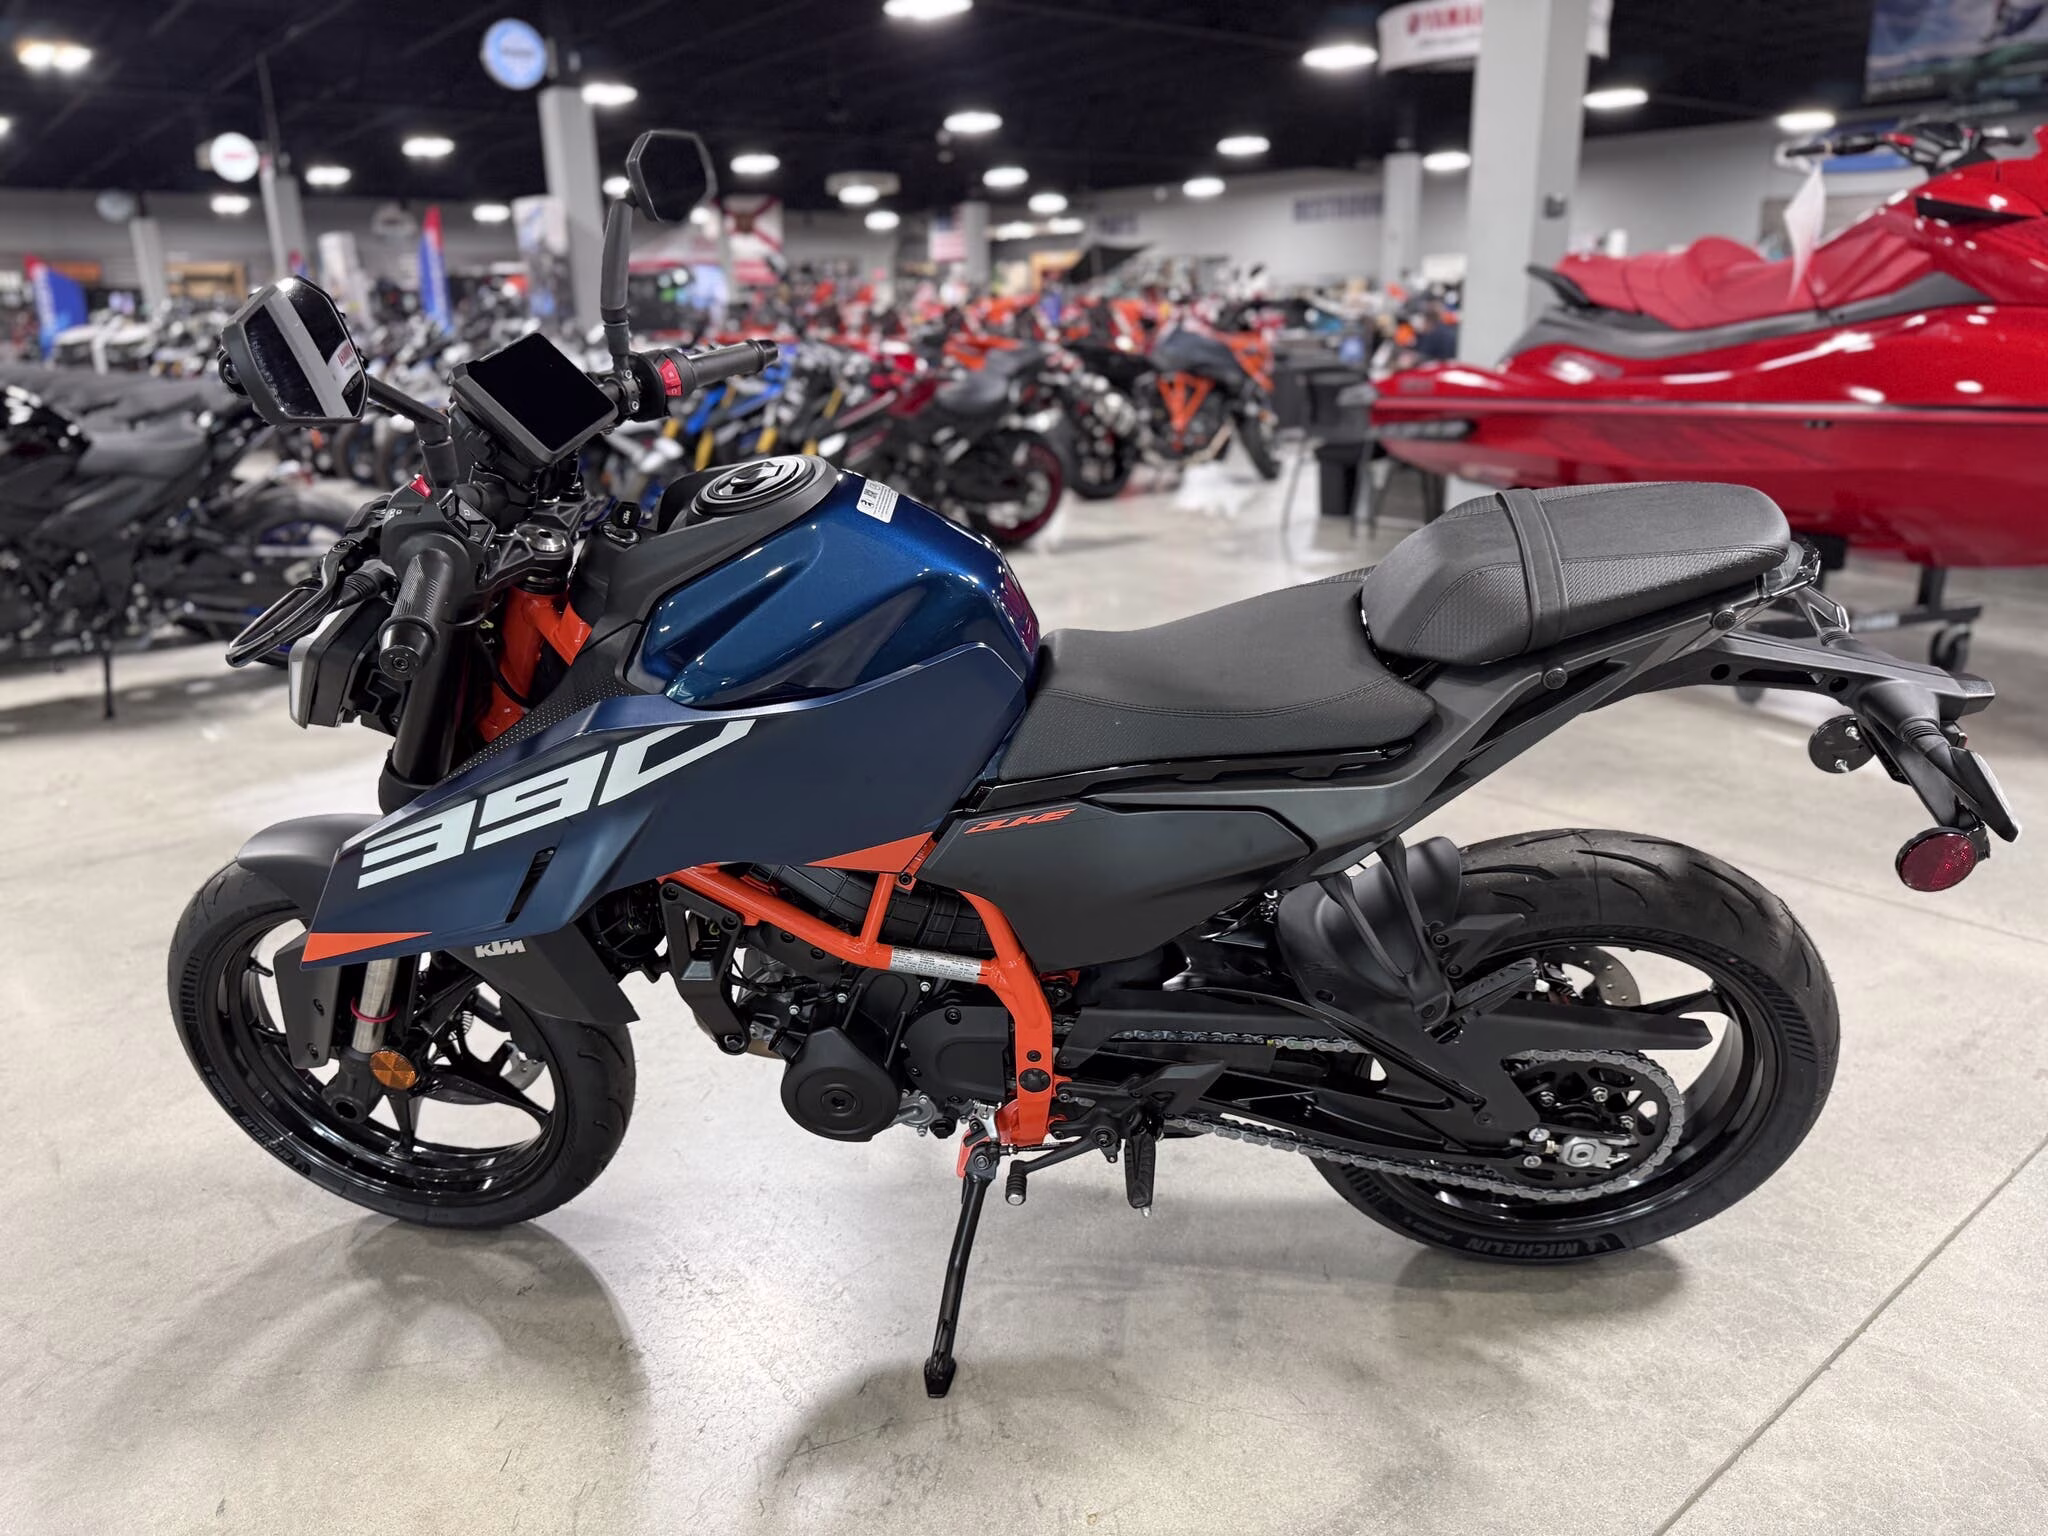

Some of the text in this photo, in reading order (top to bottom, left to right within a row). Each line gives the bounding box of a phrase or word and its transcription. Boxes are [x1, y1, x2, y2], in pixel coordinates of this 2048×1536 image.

[357, 719, 756, 889] 390
[964, 808, 1077, 834] DUKE
[474, 939, 526, 958] KTM
[1465, 1234, 1579, 1257] MICHELIN
